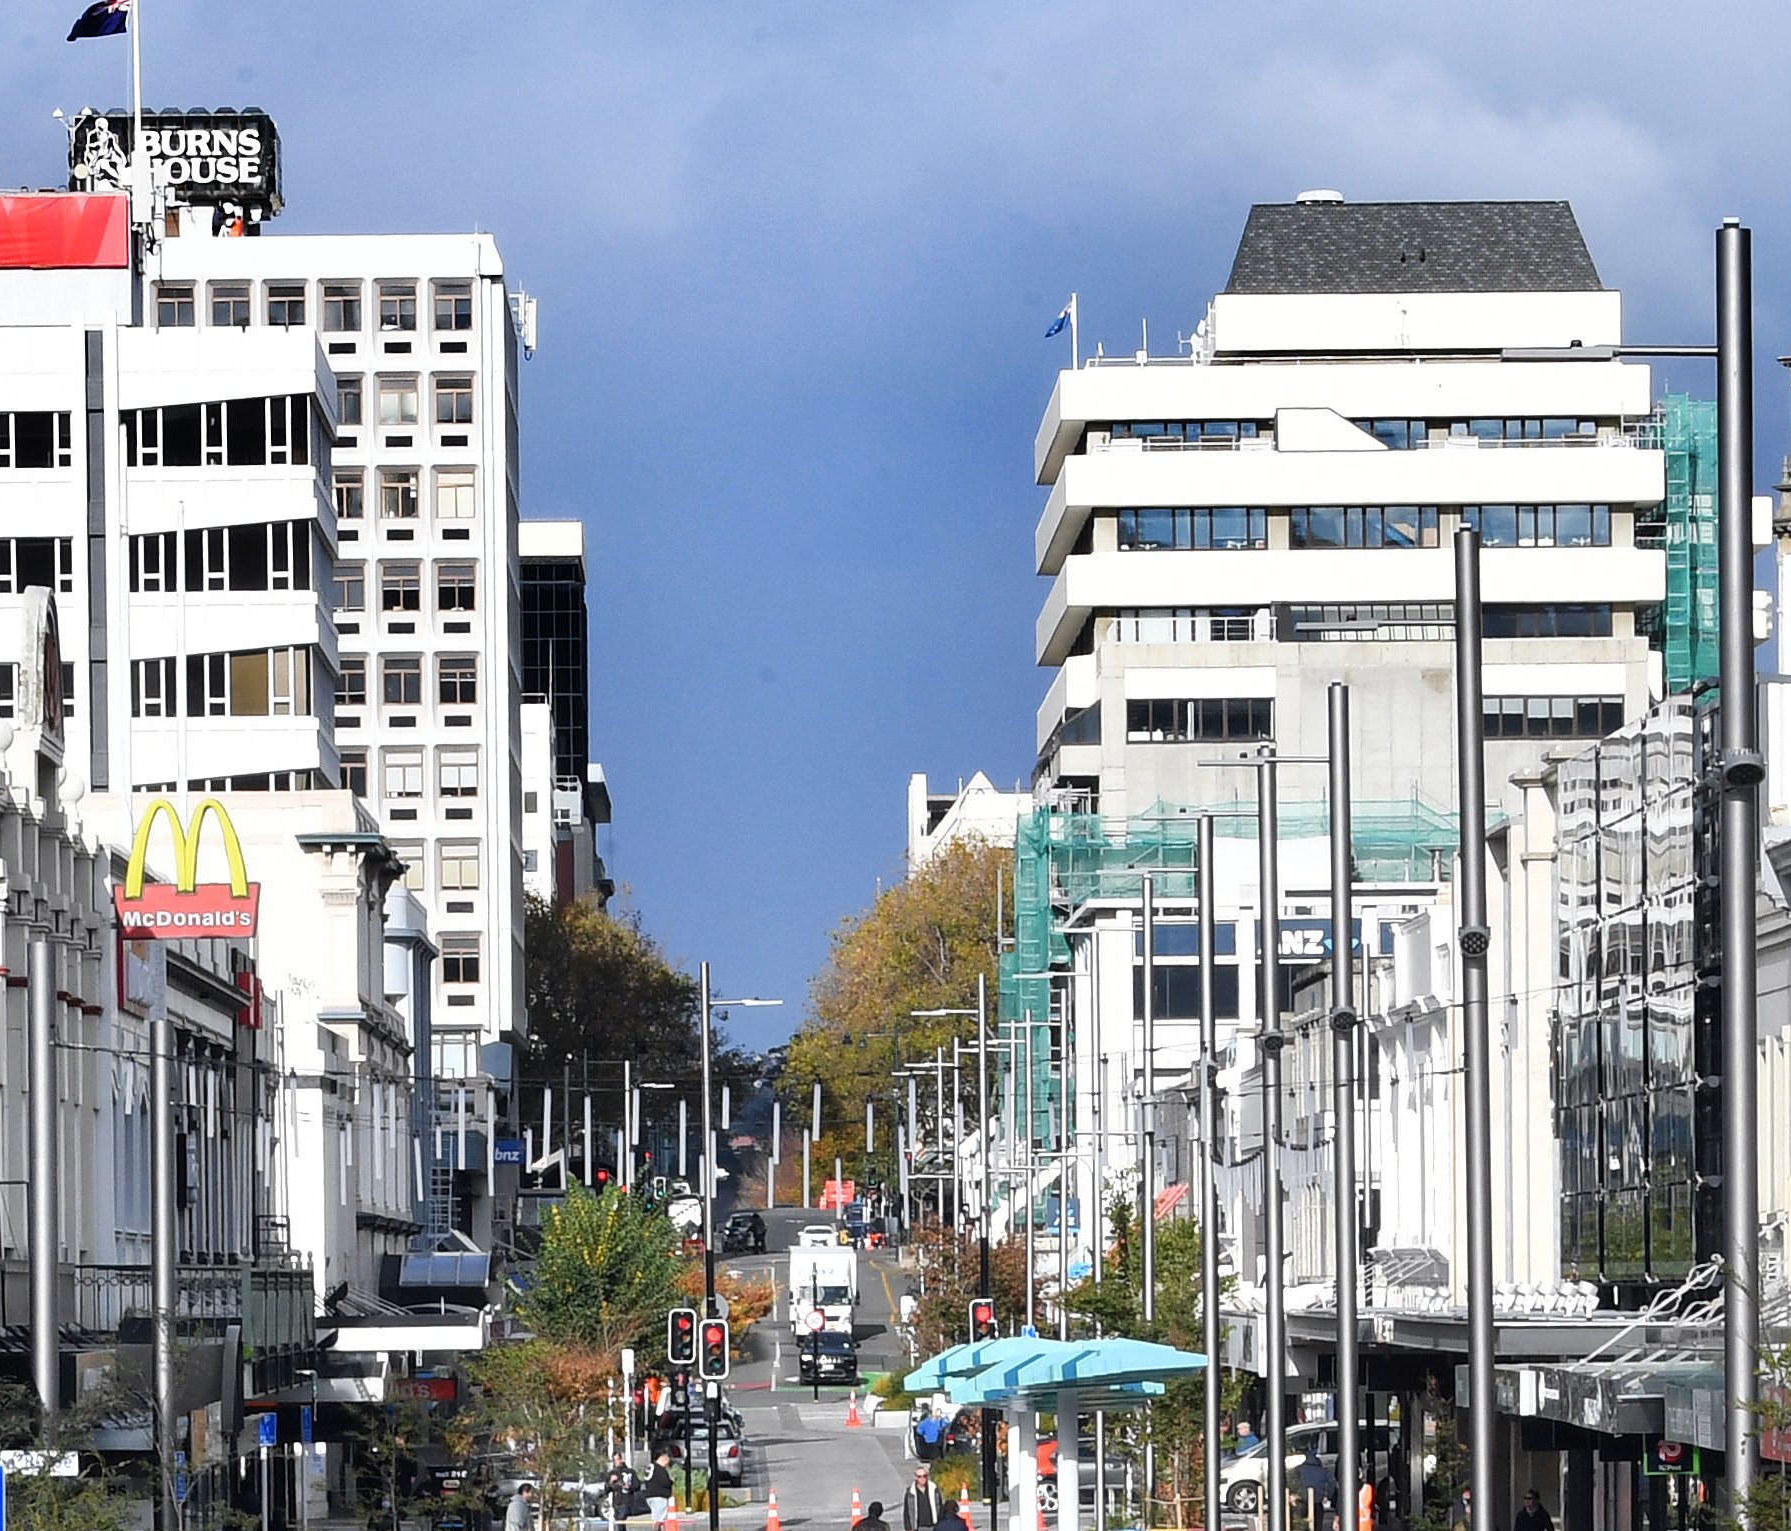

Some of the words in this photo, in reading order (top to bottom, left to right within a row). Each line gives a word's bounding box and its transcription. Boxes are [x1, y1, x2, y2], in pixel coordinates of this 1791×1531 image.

[140, 129, 261, 157] BURNS
[122, 910, 251, 928] McDonald's
[494, 1147, 521, 1161] bnz
